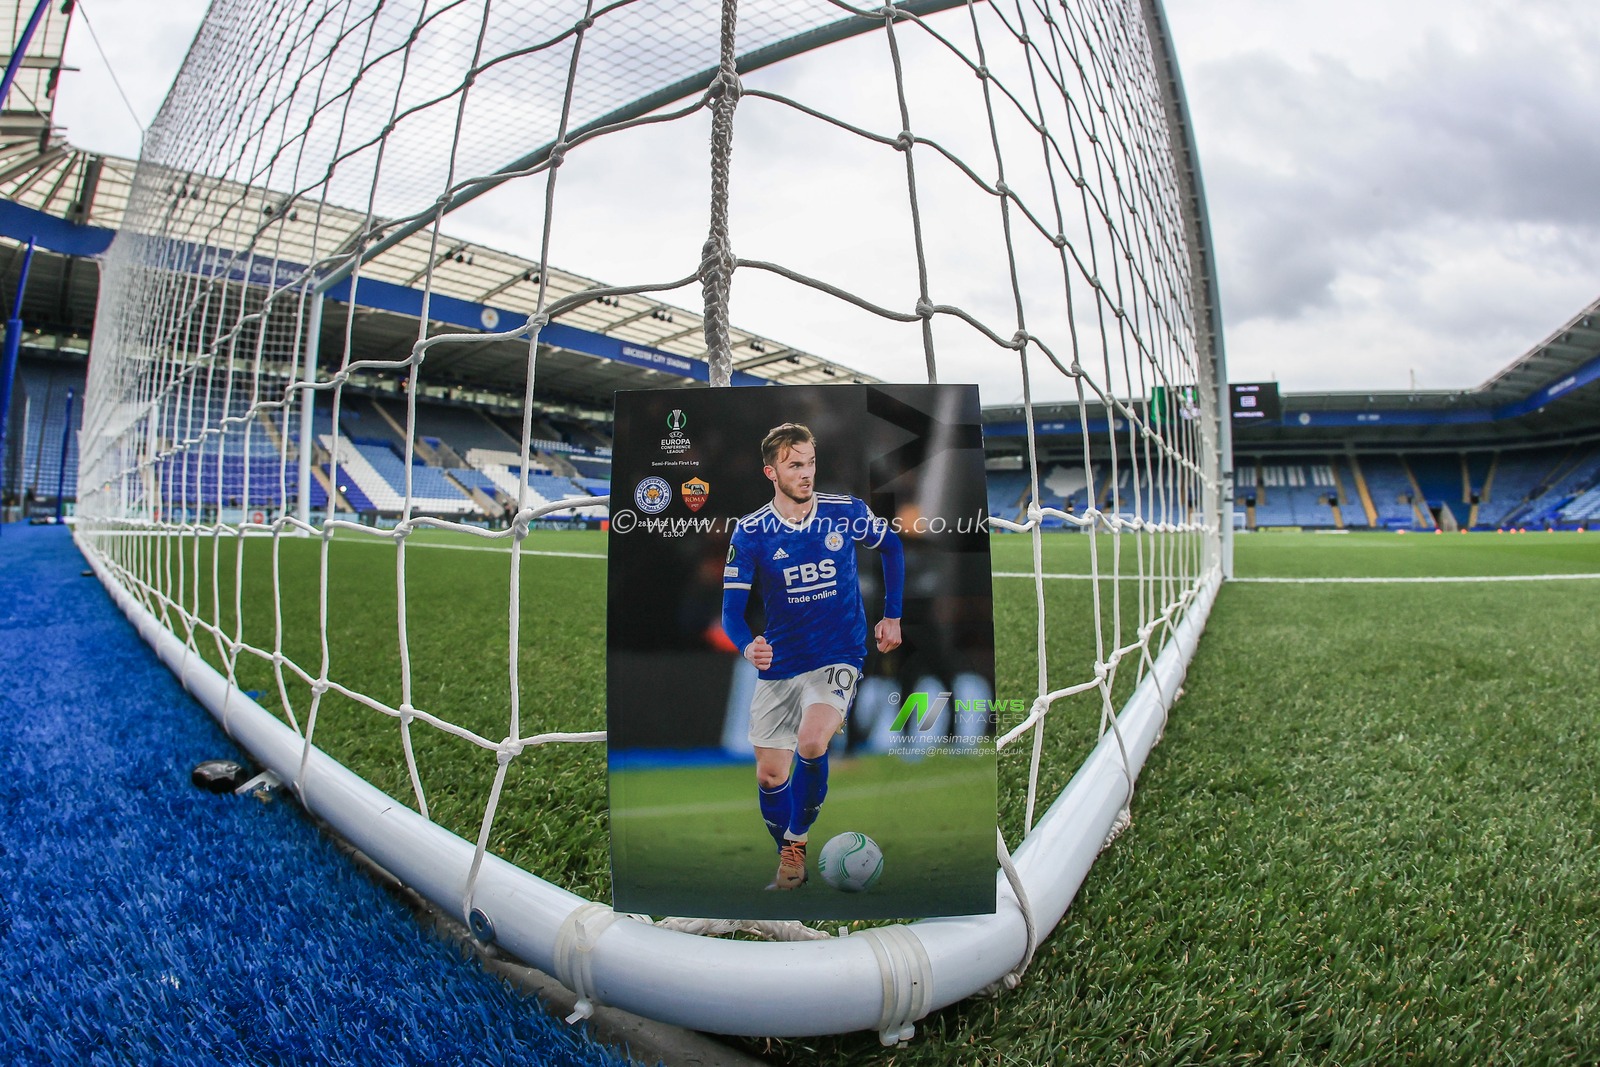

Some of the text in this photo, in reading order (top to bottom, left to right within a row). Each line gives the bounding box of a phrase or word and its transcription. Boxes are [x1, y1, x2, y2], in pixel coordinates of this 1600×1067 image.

[782, 558, 837, 586] FBS
[787, 588, 838, 604] trade online
[824, 666, 854, 691] 10
